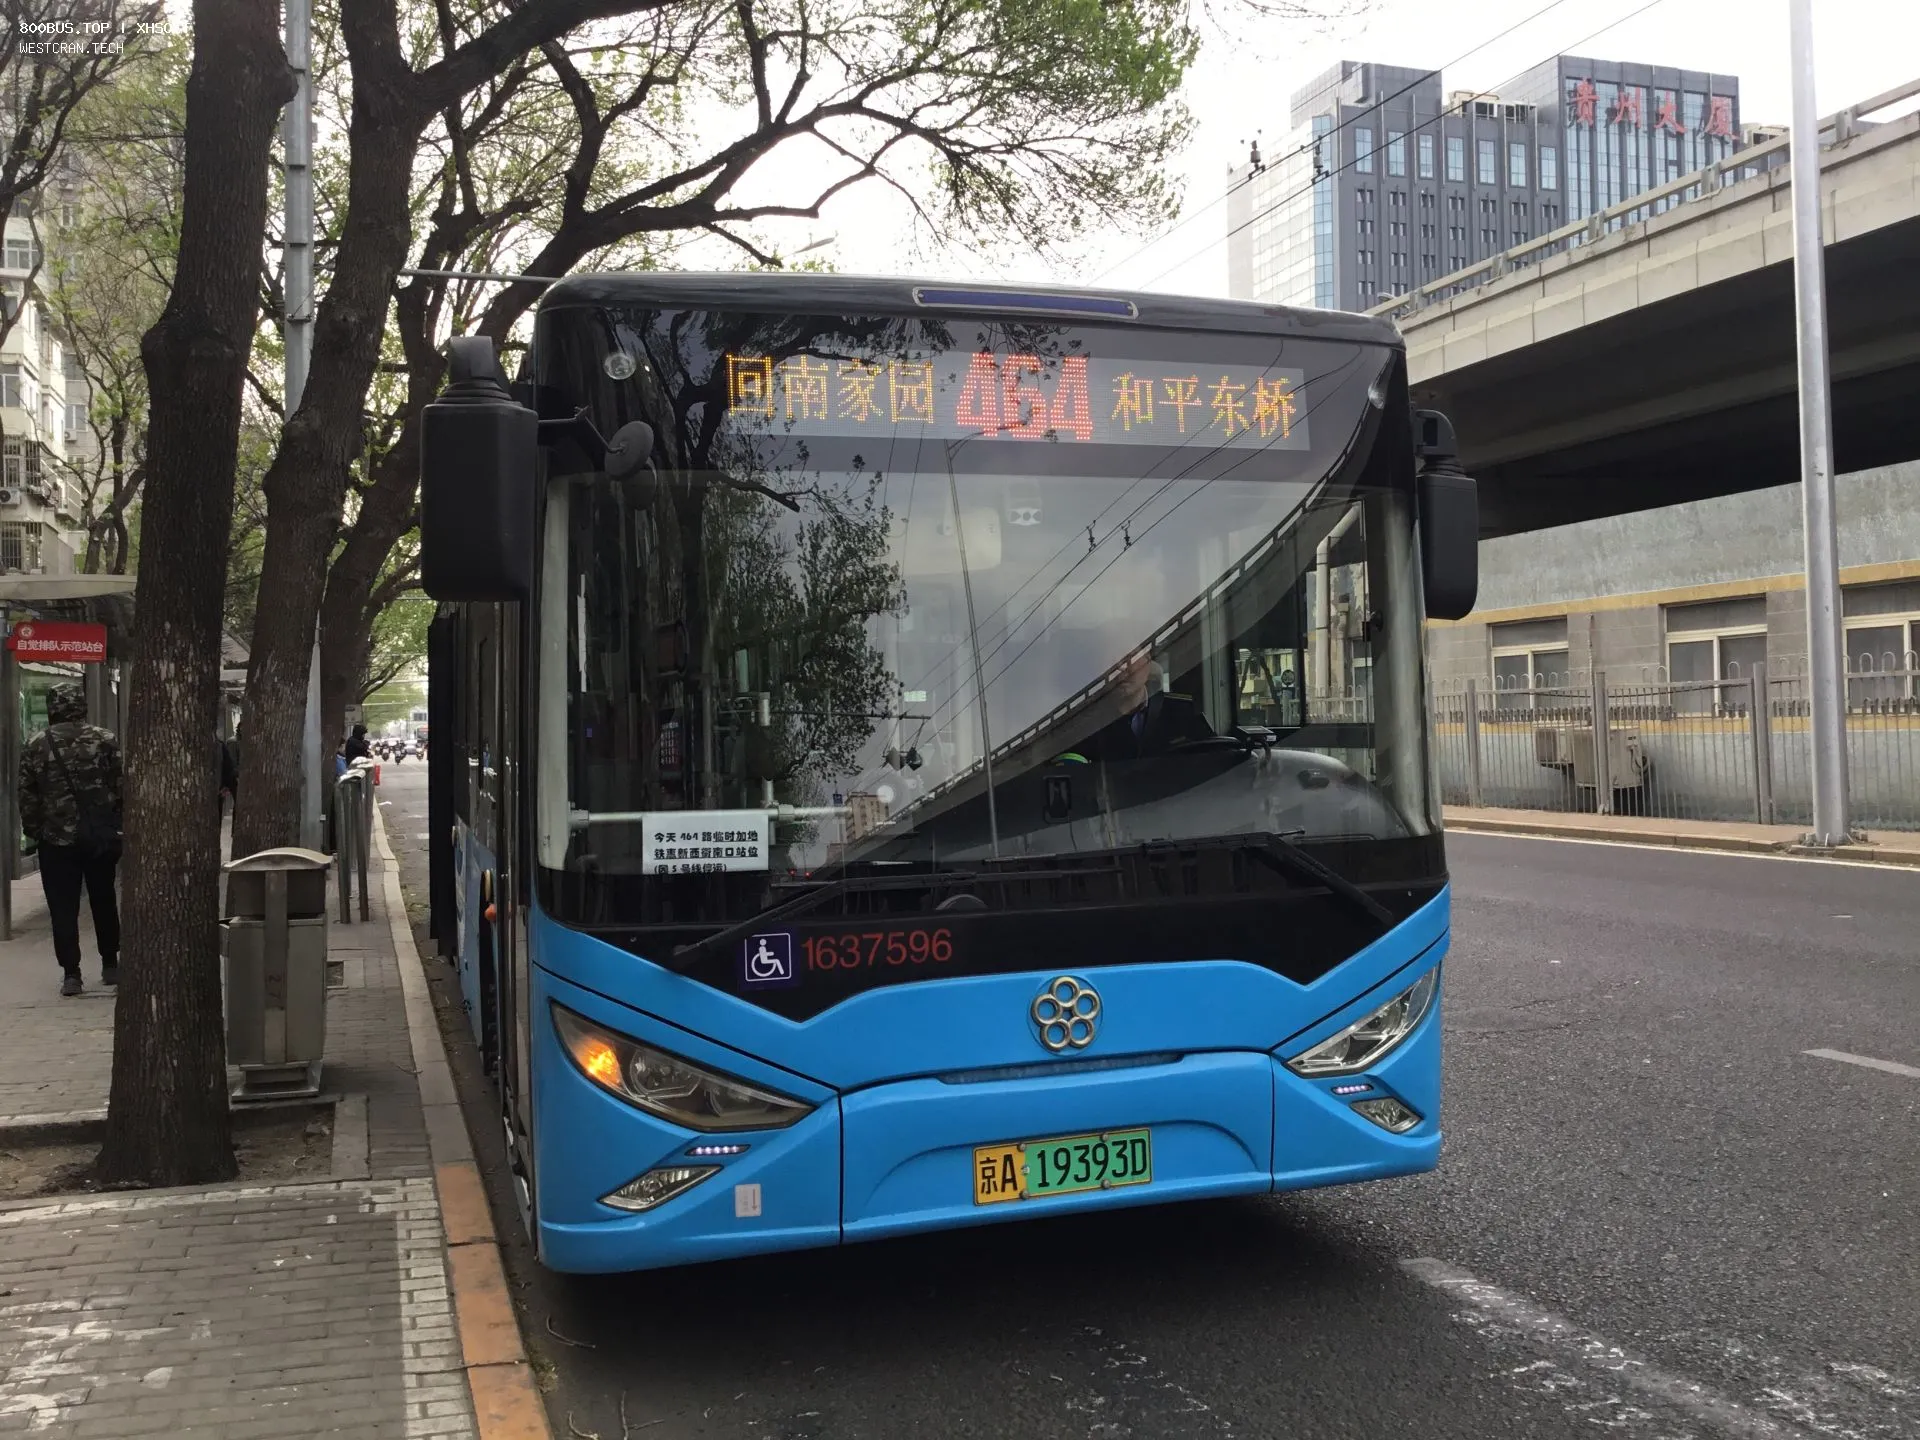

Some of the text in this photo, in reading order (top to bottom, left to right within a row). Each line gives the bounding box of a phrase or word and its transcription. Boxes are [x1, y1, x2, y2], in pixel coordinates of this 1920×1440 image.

[1571, 76, 1740, 140] 贵州大厦
[726, 351, 1297, 440] 回南家园 464 和平东桥
[17, 639, 104, 653] 自觉排队示范站台
[654, 832, 677, 843] 今天
[802, 928, 952, 970] 1637596
